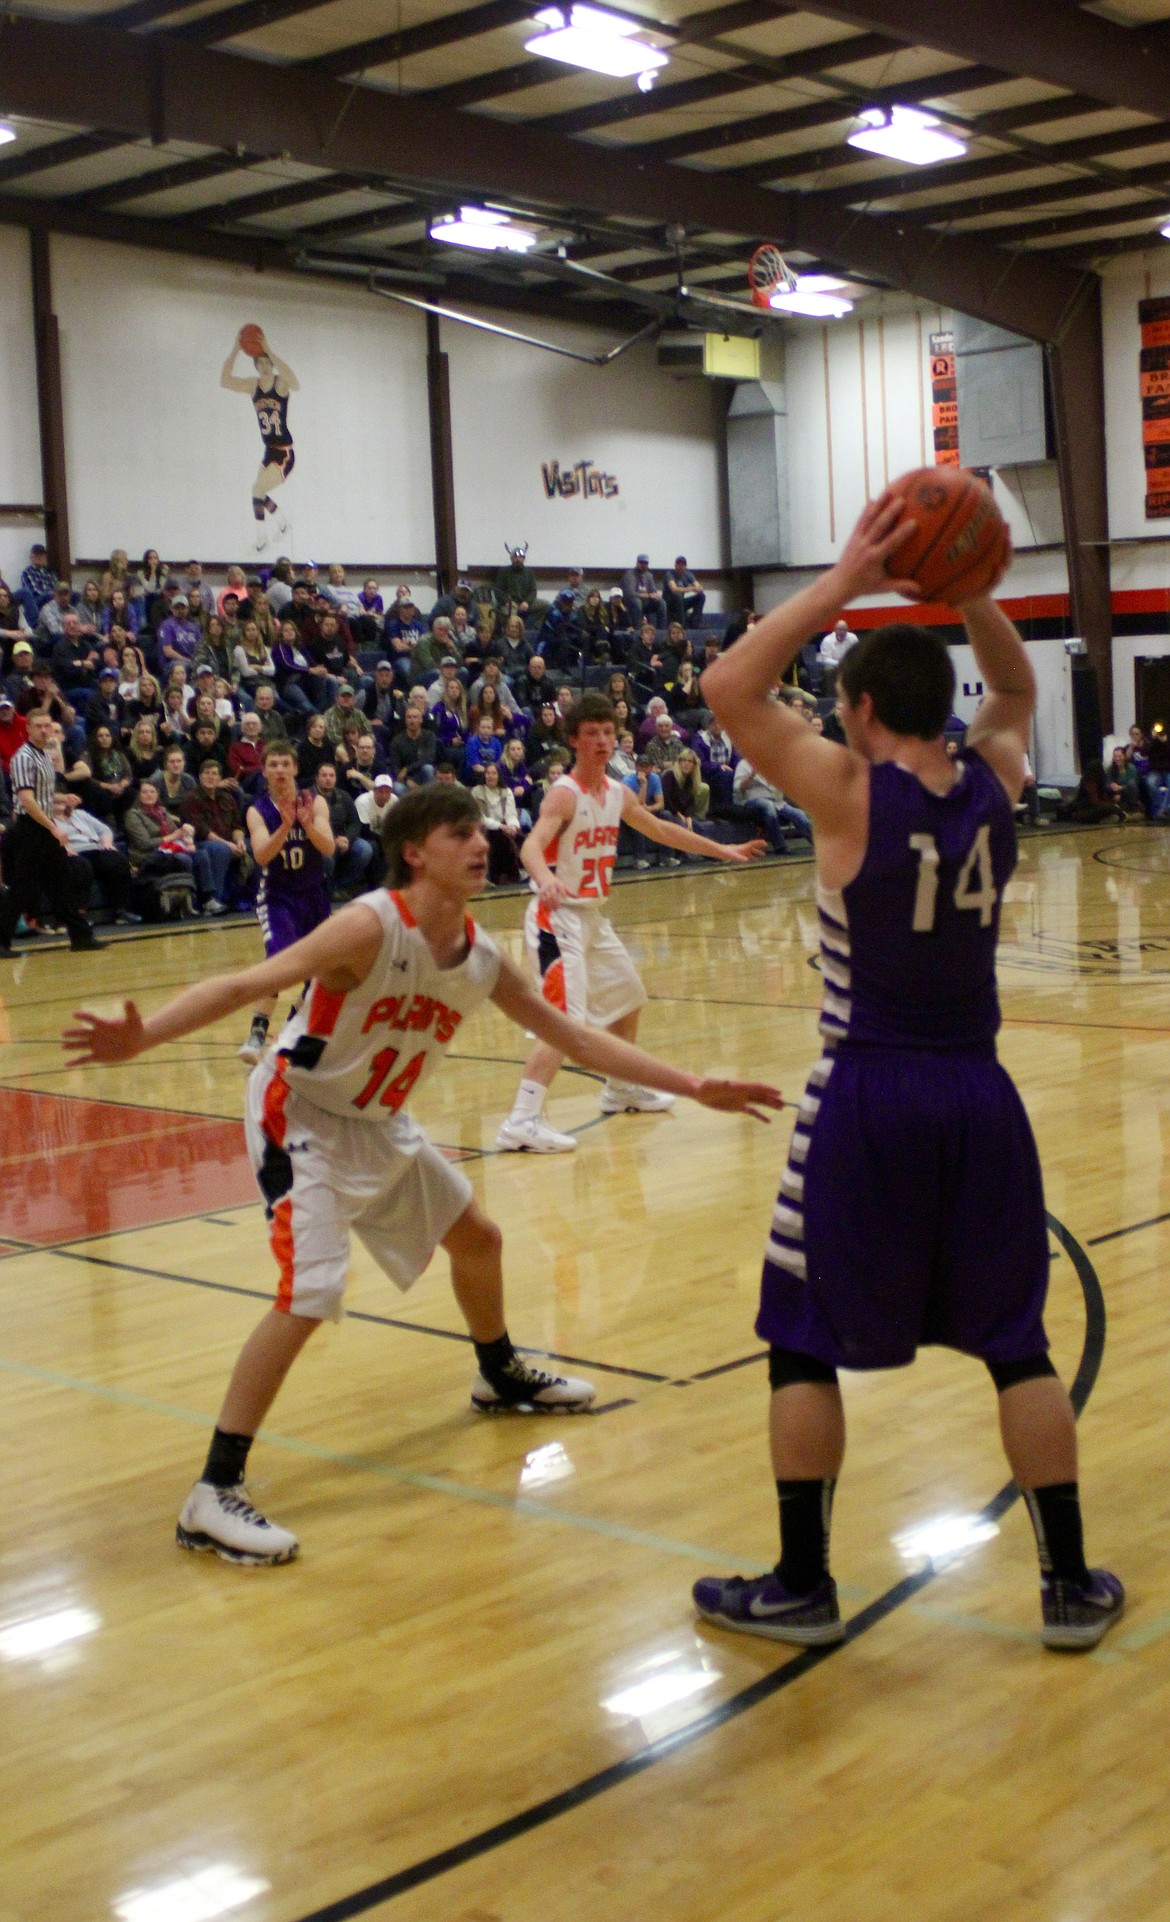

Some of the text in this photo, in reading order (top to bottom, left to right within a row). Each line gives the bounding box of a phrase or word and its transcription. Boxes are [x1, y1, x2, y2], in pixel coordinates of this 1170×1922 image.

[259, 410, 282, 437] 34
[281, 846, 304, 870] 10
[908, 824, 998, 933] 14
[350, 1046, 427, 1117] 14
